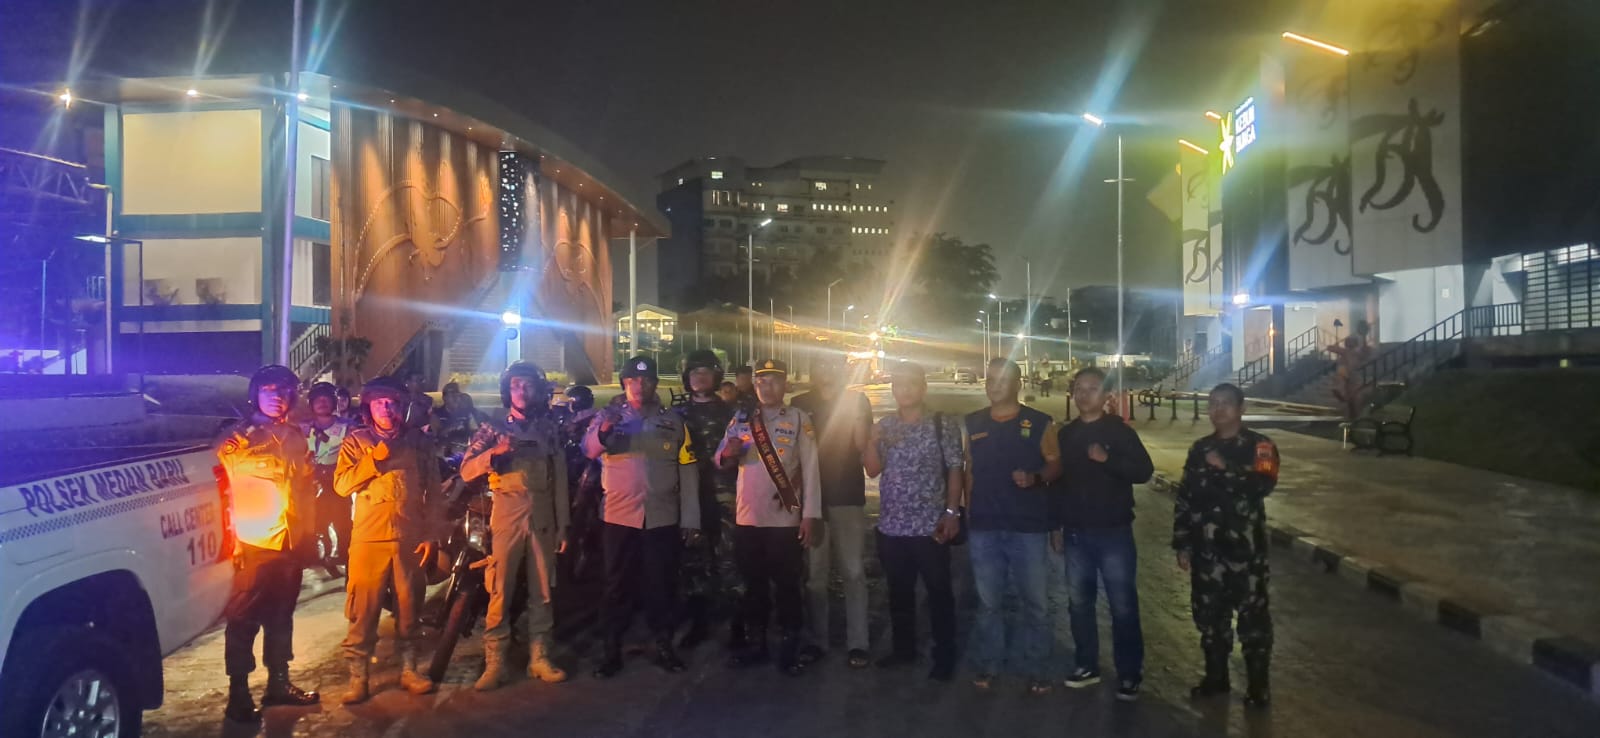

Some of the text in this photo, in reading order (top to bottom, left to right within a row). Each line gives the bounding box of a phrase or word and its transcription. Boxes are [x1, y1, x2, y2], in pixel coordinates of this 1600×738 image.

[18, 458, 190, 517] POLSEK MEDAN BARU
[160, 511, 184, 540] CALL
[187, 530, 217, 565] 110
